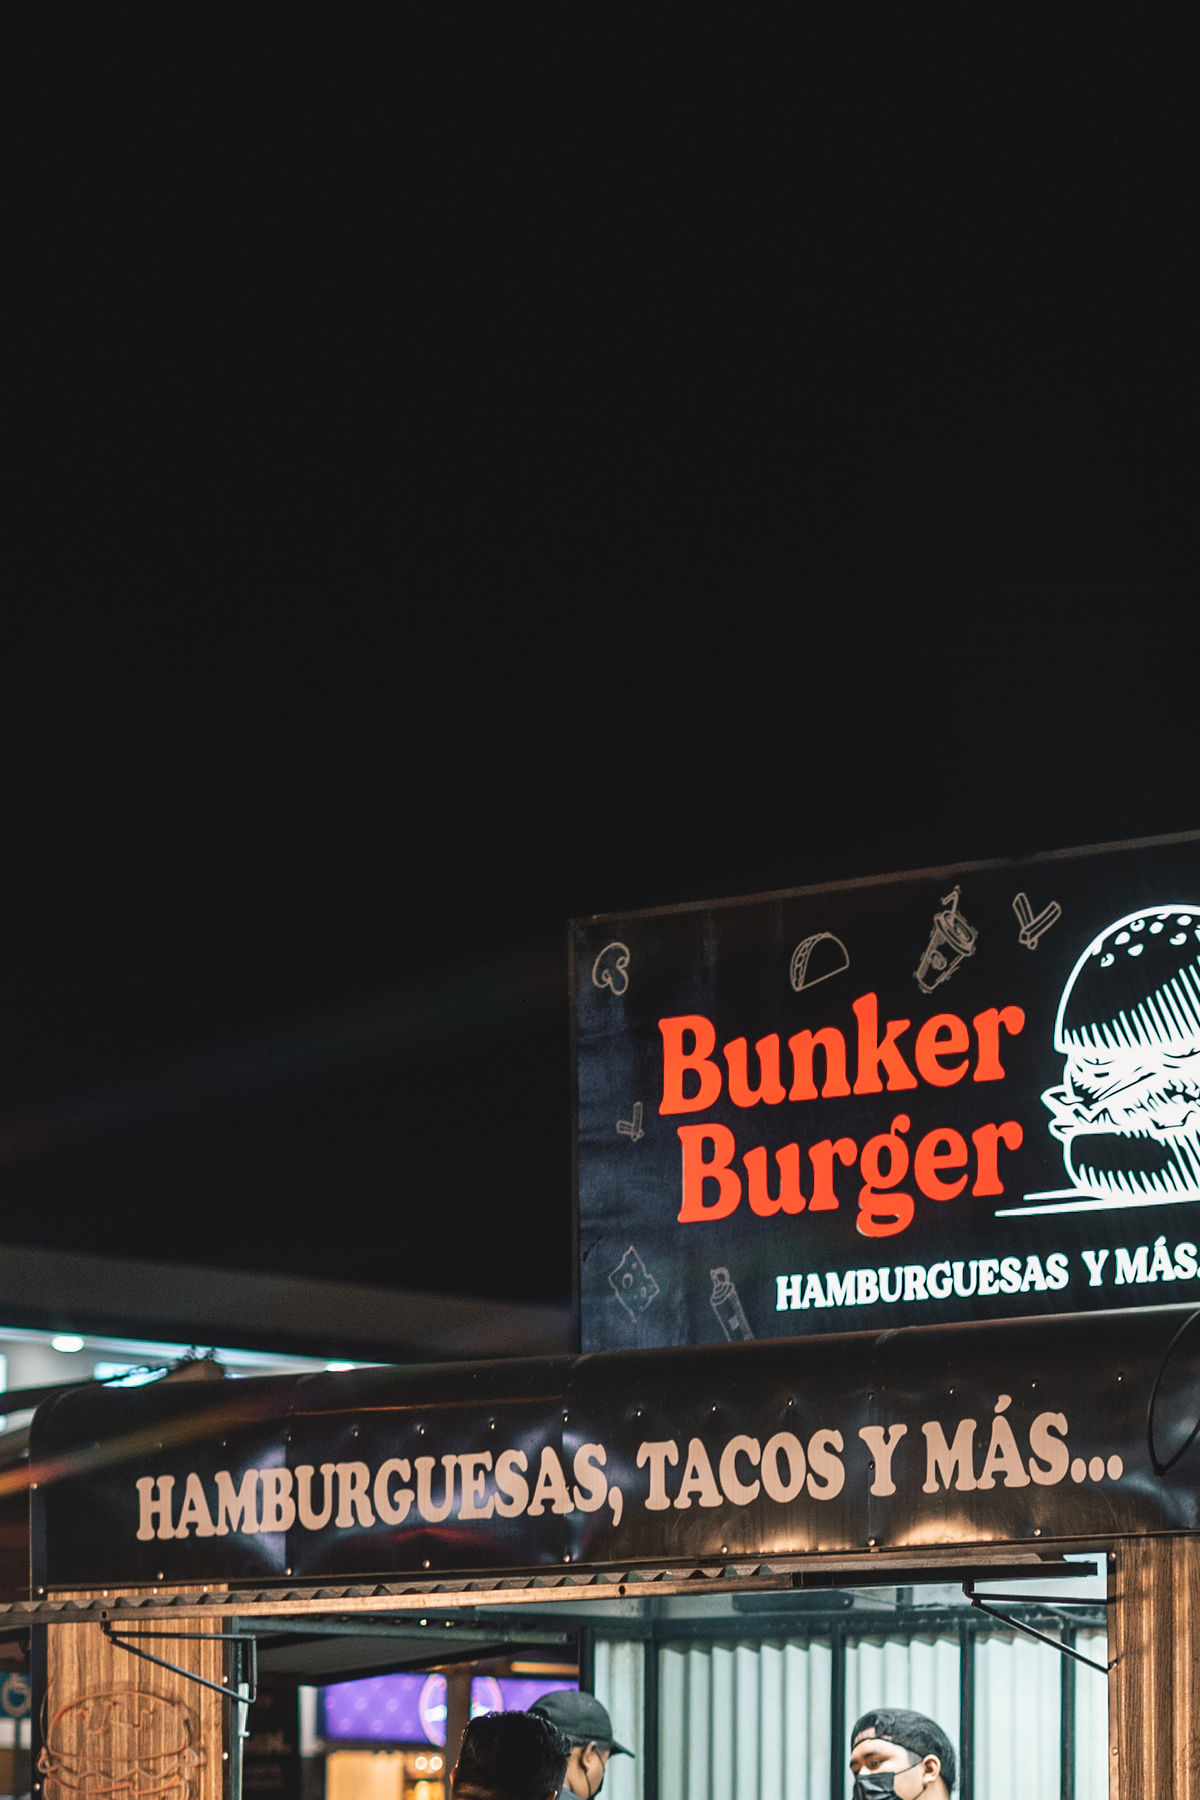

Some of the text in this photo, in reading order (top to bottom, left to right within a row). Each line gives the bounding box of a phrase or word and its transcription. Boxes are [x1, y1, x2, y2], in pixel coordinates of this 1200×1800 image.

[657, 991, 1026, 1116] Bunker
[676, 1113, 1025, 1238] Burger
[775, 1252, 1070, 1312] HAMBURGUESAS
[1080, 1248, 1110, 1287] Y
[135, 1434, 624, 1541] HAMBURGUESAS,
[636, 1428, 846, 1512] TACOS
[858, 1423, 908, 1497] Y
